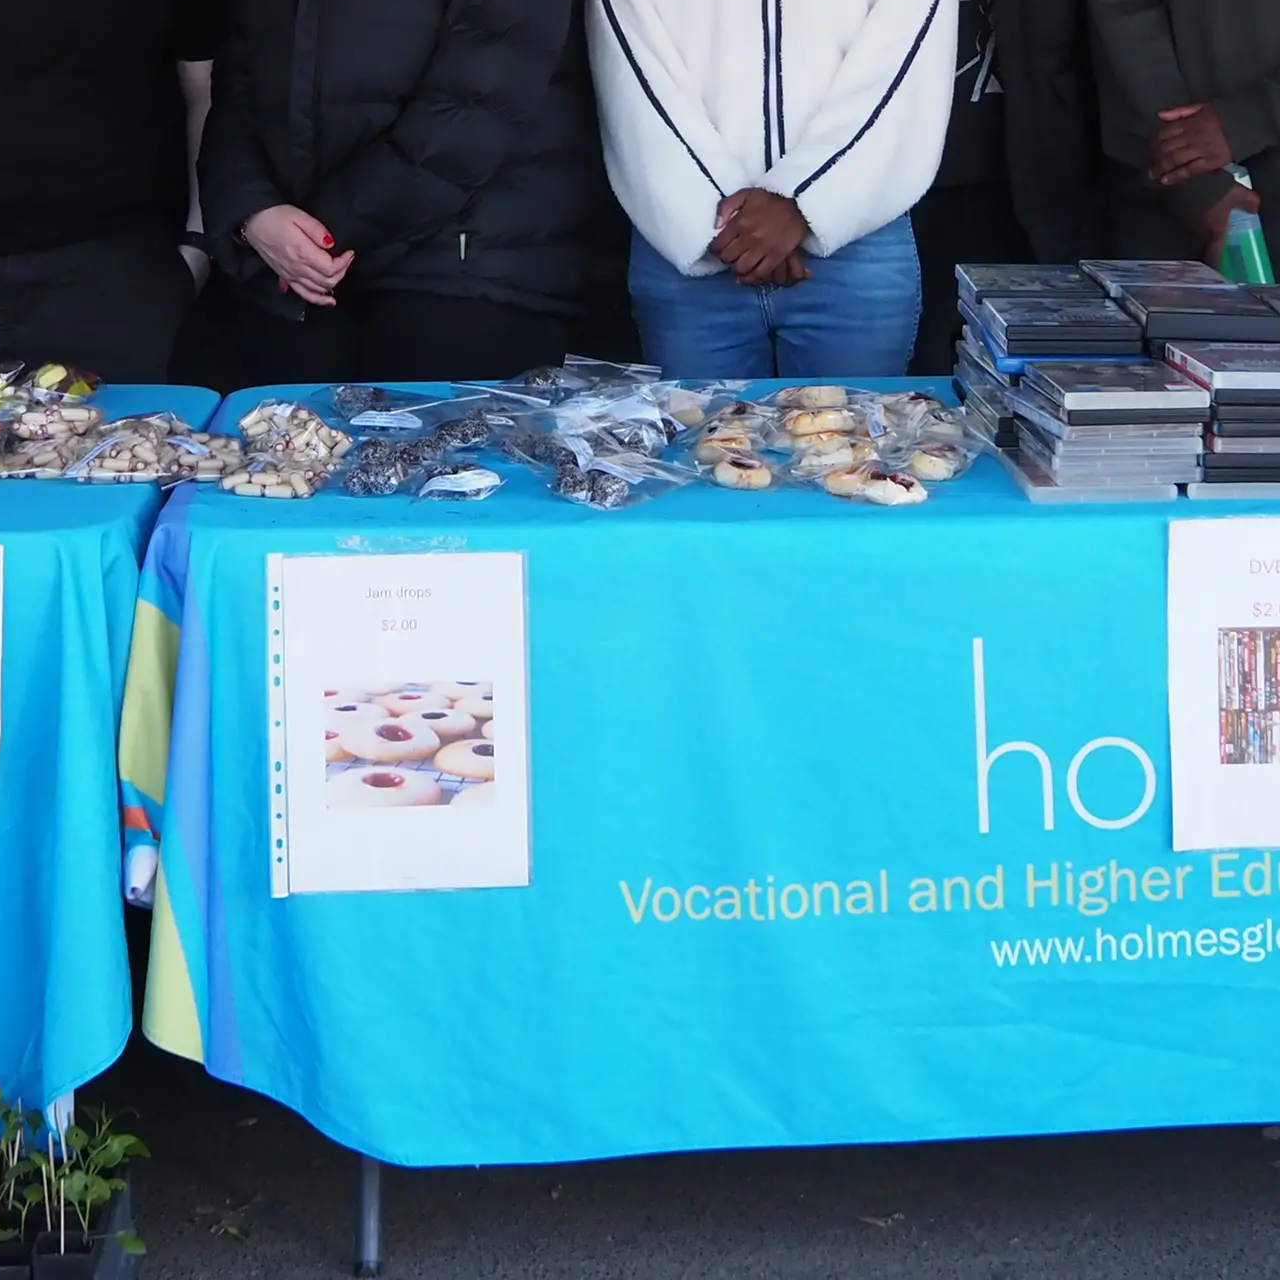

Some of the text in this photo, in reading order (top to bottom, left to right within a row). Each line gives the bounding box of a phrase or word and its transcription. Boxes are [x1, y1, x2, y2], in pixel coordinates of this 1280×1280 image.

[364, 585, 432, 600] Jam drops
[619, 869, 888, 924] Vocational
[908, 865, 1005, 913] and
[1026, 856, 1193, 917] Higher
